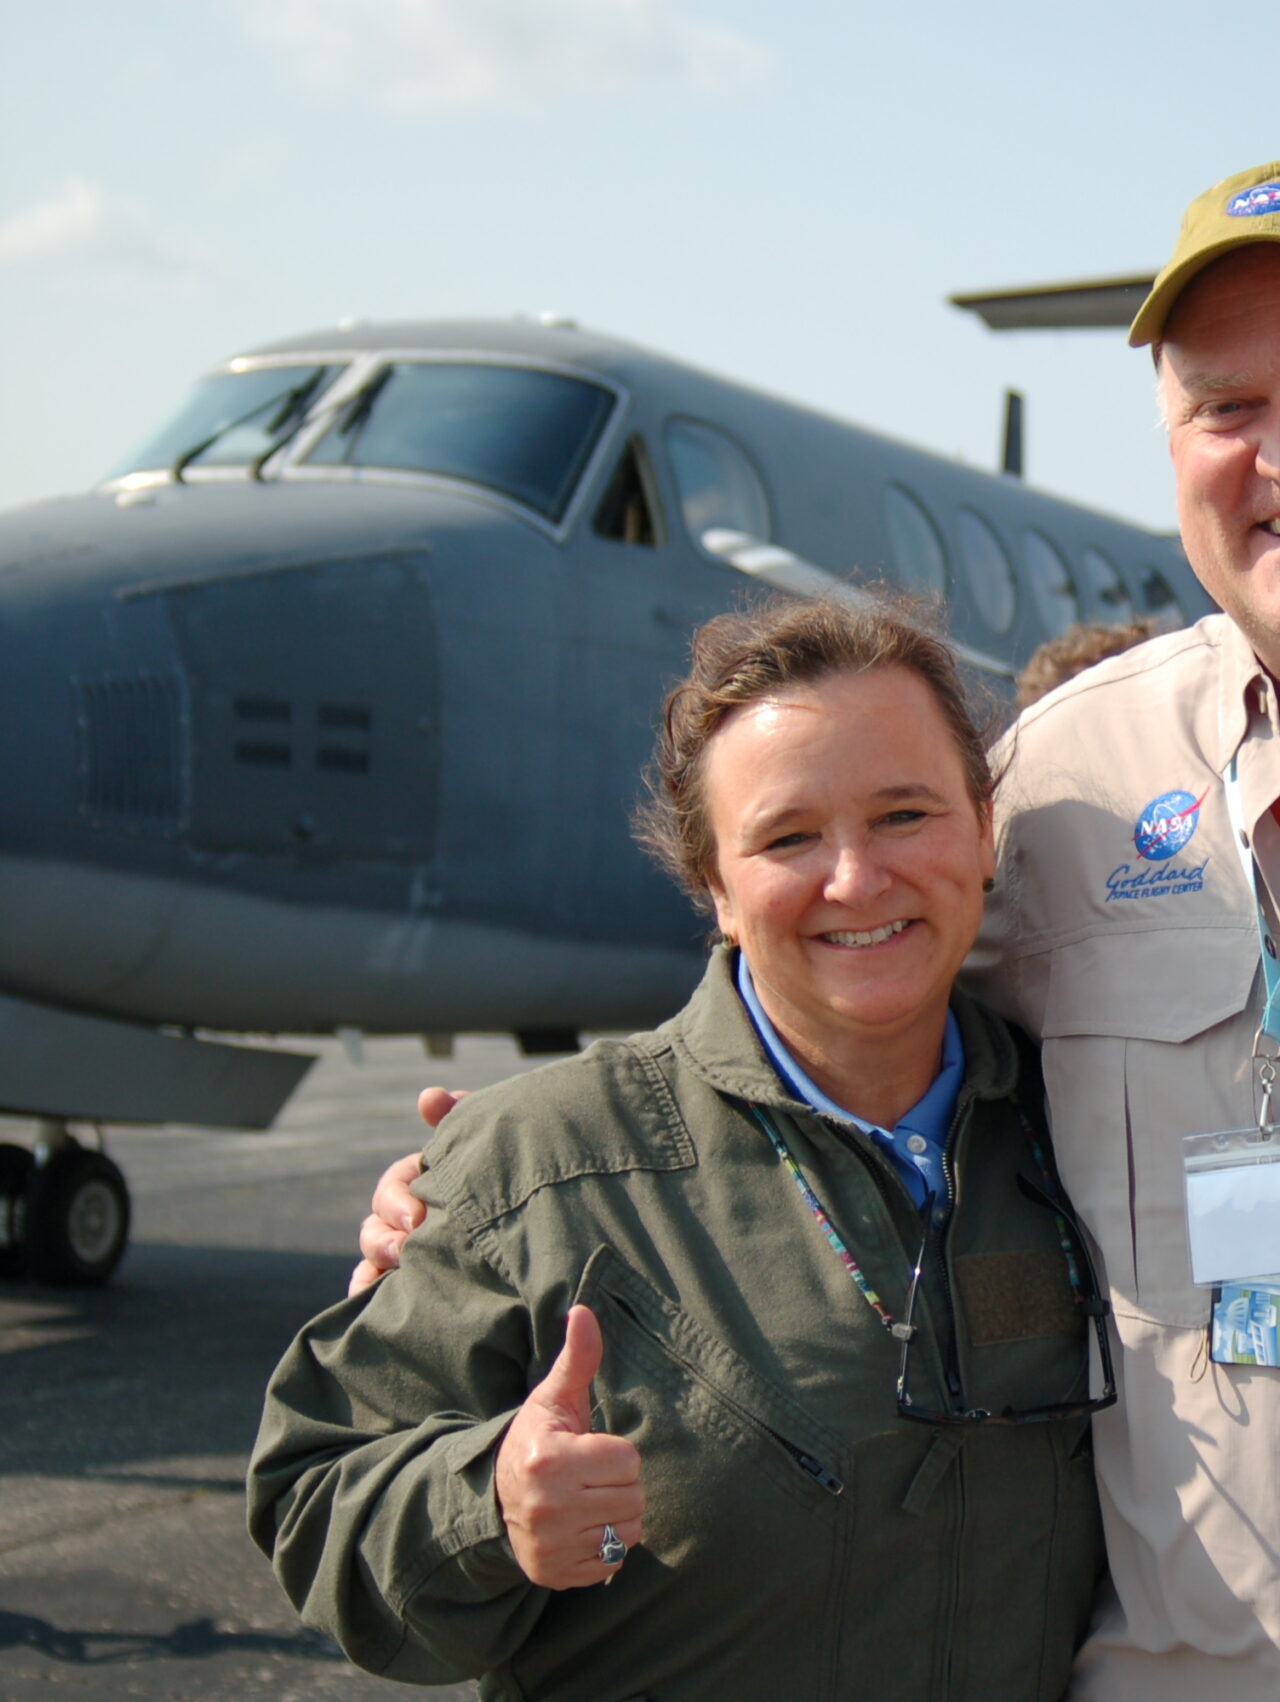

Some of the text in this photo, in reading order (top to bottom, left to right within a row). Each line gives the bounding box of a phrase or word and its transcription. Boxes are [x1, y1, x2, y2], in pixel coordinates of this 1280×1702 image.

[1141, 815, 1193, 836] NASA
[1105, 857, 1210, 902] Goddard
[1113, 882, 1203, 899] SPACE FLIGHT CENTER
